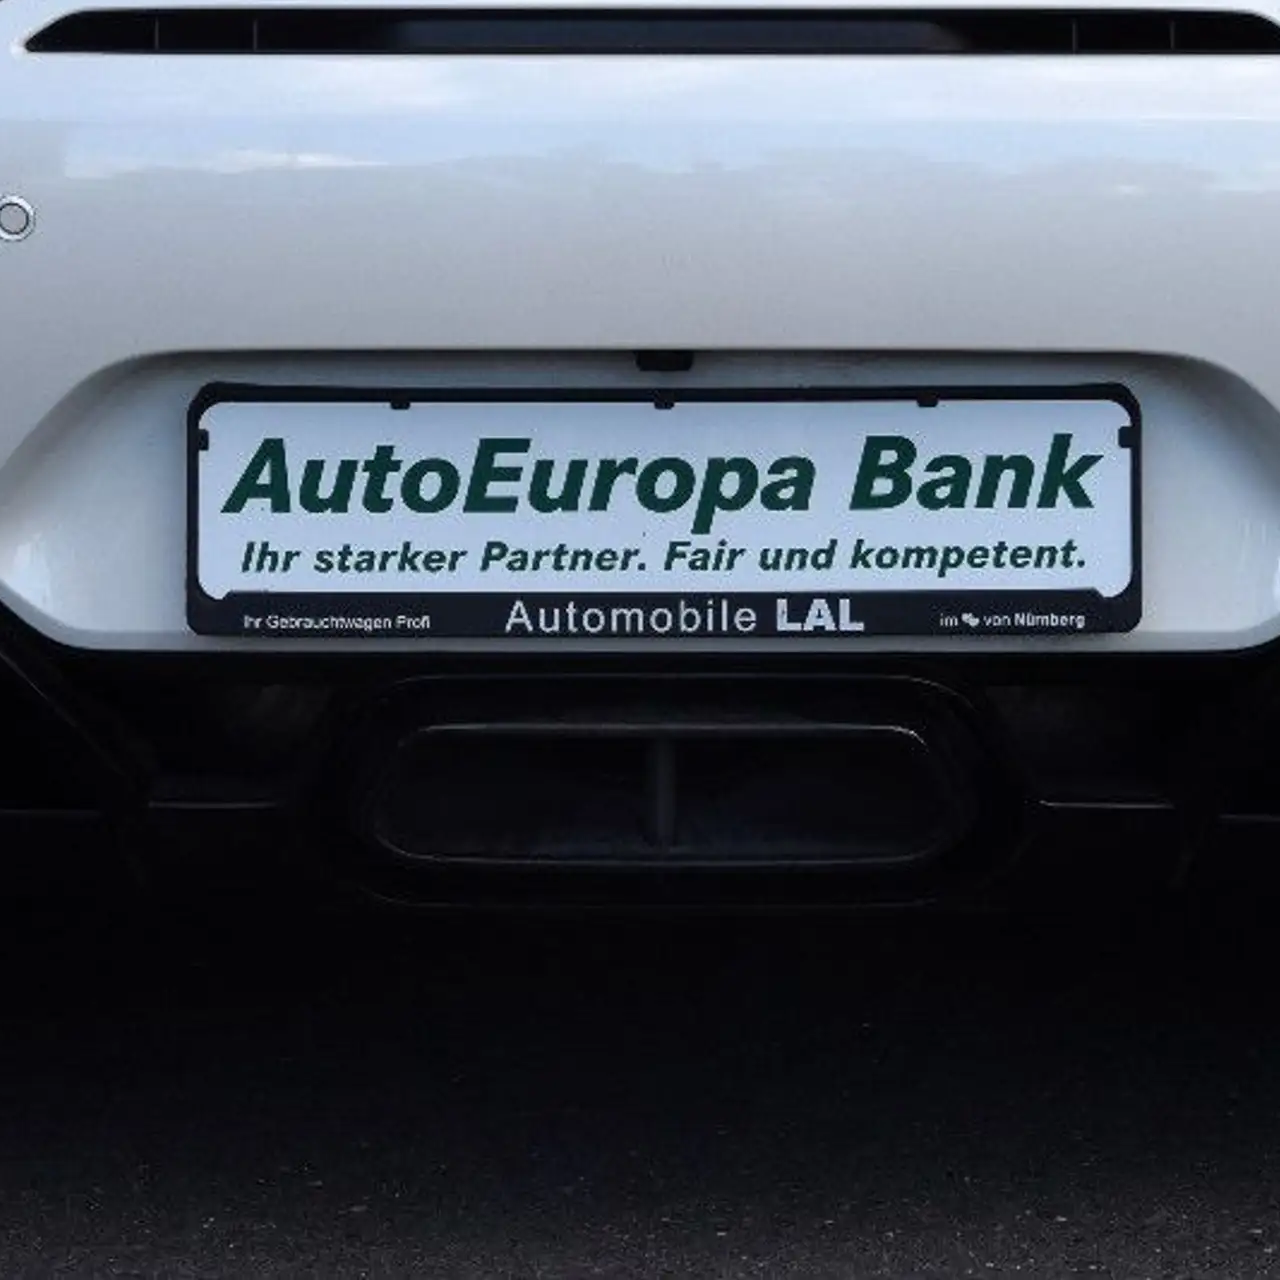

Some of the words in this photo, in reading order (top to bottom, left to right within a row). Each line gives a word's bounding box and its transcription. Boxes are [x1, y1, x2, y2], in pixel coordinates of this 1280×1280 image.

[220, 437, 816, 535] AutoEuropa
[849, 433, 1104, 511] Bank
[241, 541, 302, 573] Ihr
[313, 541, 468, 574] starker
[480, 541, 646, 572] Partner.
[663, 539, 747, 571] Fair
[758, 538, 838, 571] und
[849, 538, 1086, 578] kompetent.
[244, 615, 263, 629] Ihr
[266, 614, 392, 631] Gebrauchtwagen
[396, 614, 431, 629] Profi
[505, 599, 757, 634] Automobile
[776, 598, 865, 632] LAL
[939, 614, 959, 627] im
[983, 615, 1012, 627] von
[1014, 611, 1086, 629] Nürnberg
